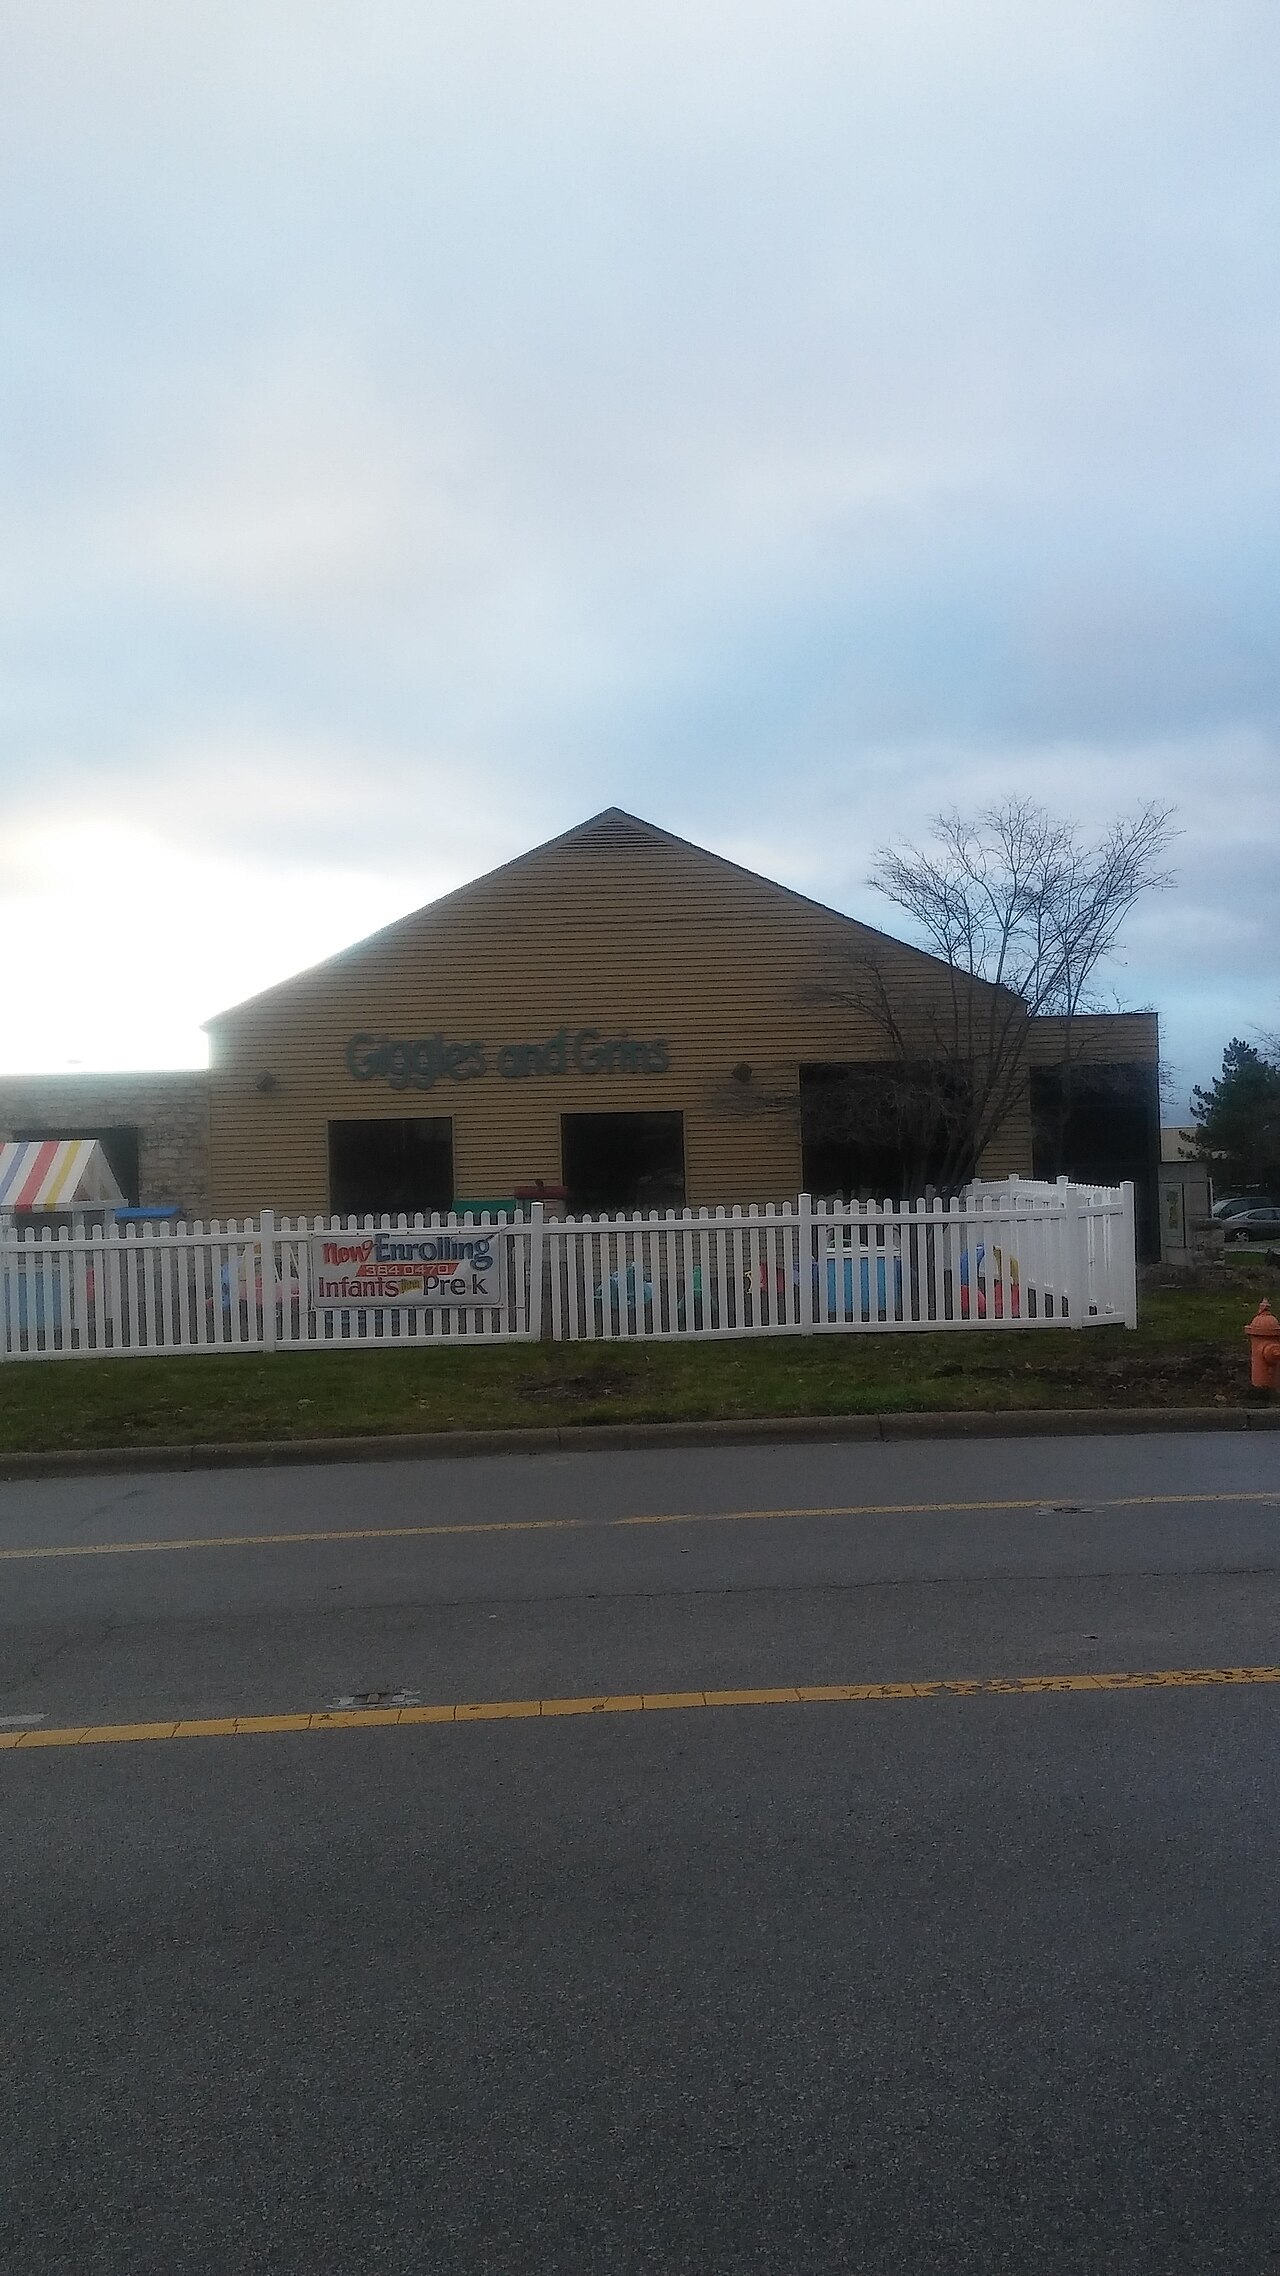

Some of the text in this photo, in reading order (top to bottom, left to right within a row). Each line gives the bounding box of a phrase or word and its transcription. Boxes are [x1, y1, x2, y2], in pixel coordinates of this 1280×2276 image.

[345, 1025, 670, 1090] Giggles and Grins
[374, 1233, 495, 1272] Enrolling
[318, 1276, 400, 1298] Infants
